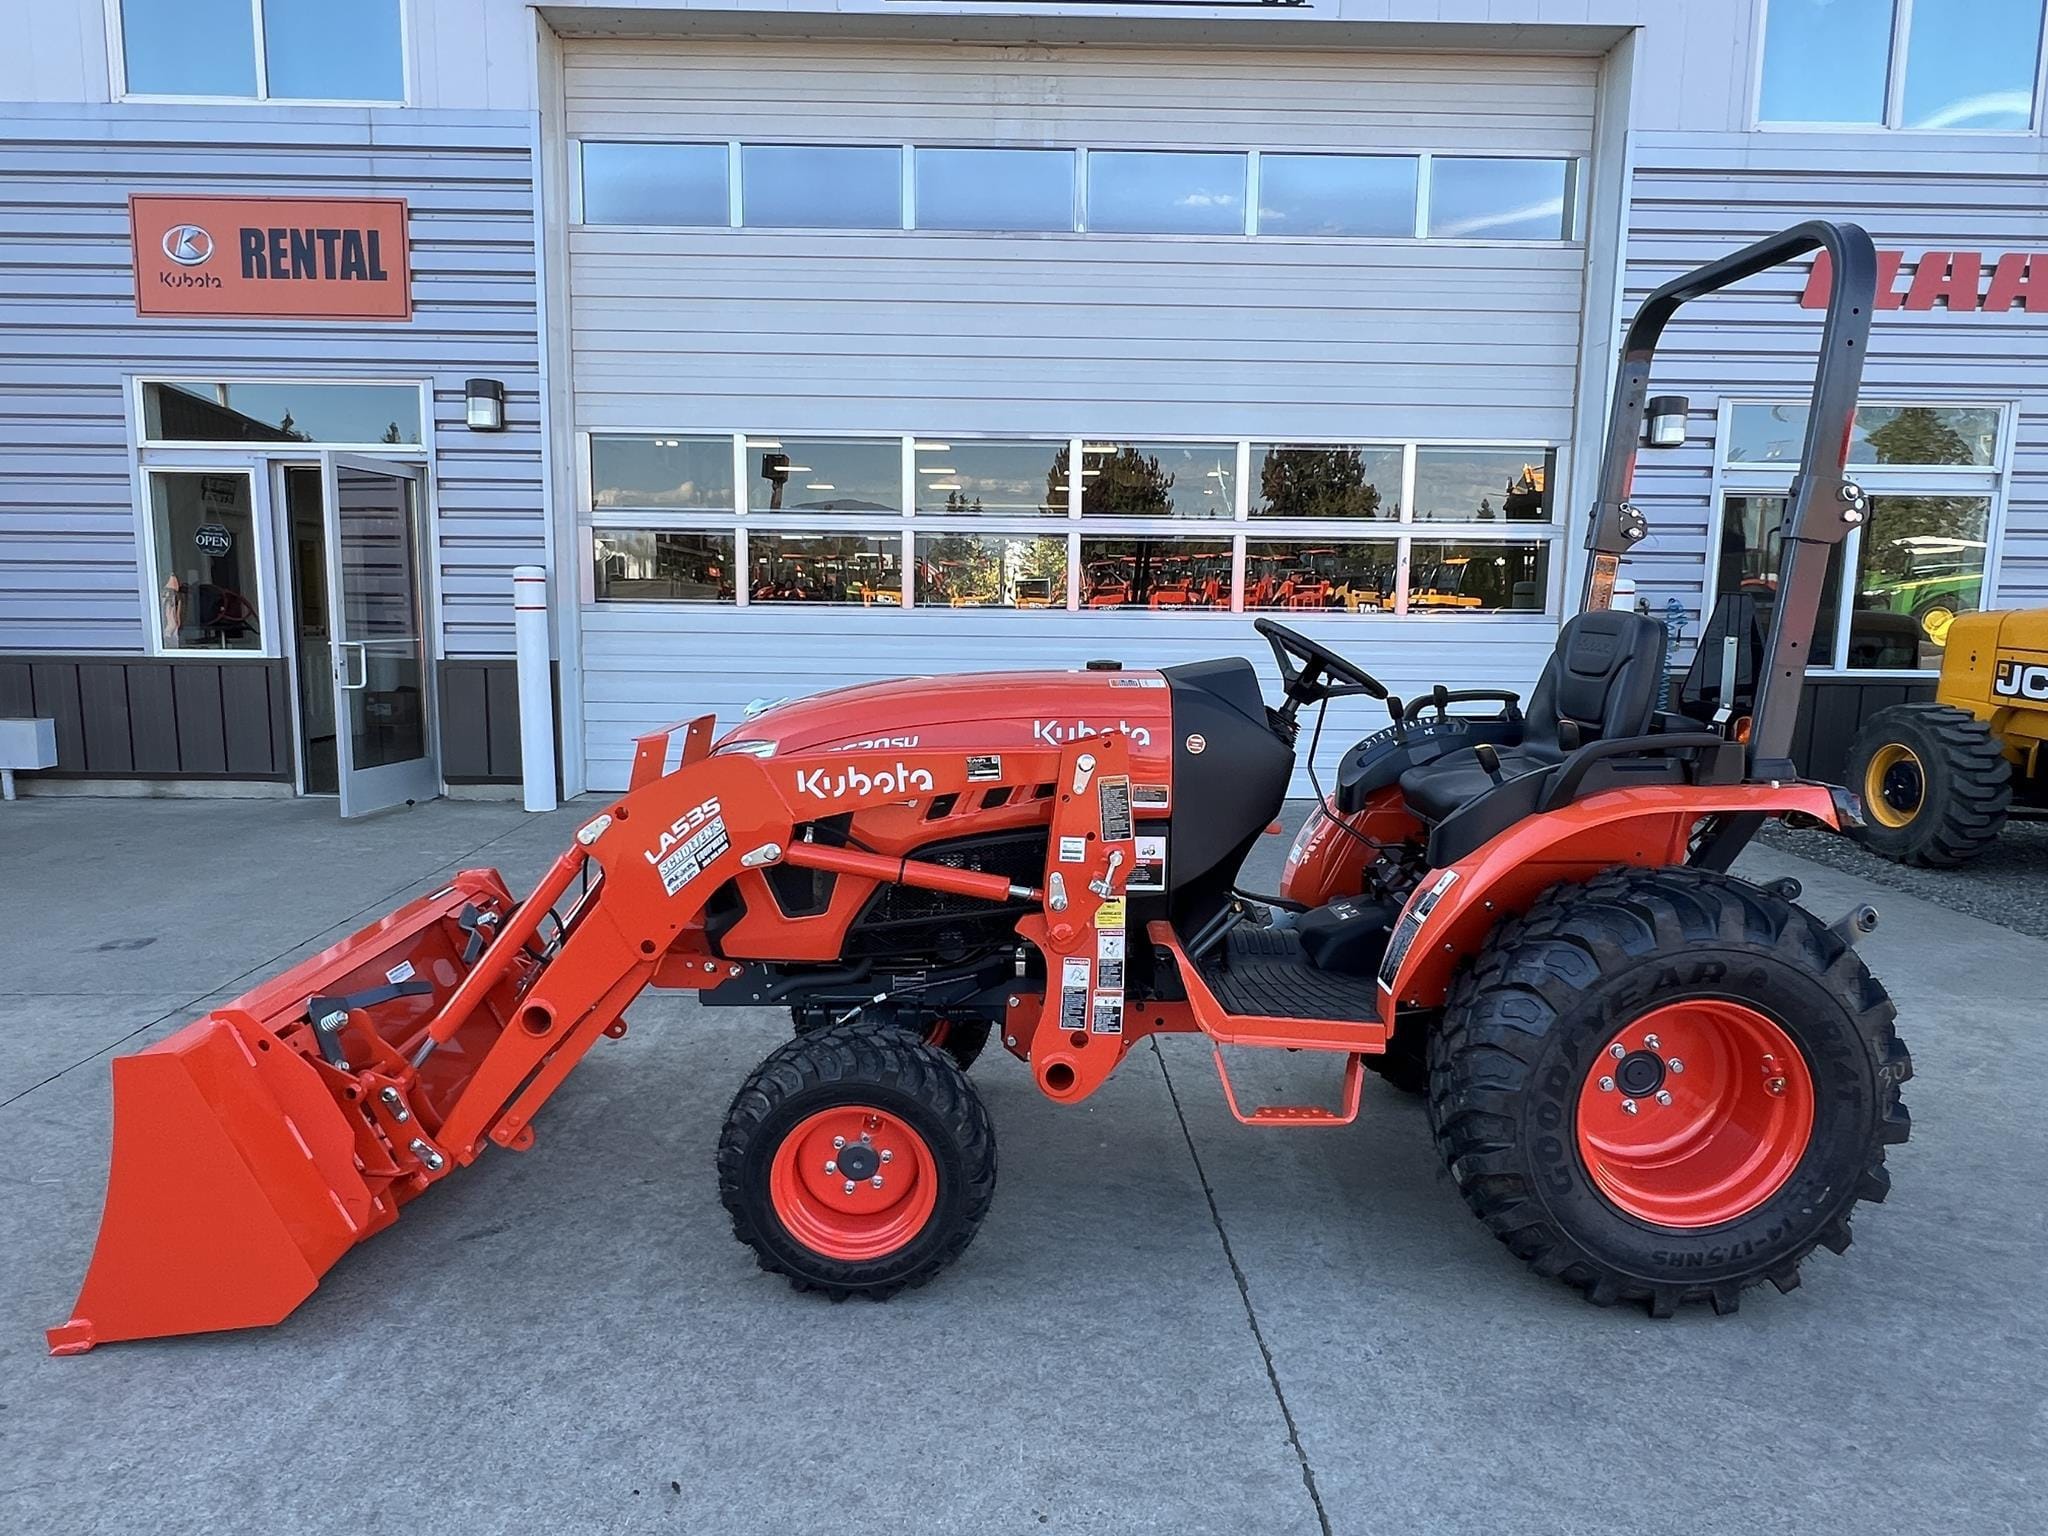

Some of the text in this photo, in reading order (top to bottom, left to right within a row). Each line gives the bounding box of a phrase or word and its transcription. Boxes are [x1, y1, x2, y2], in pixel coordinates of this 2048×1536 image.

[240, 228, 387, 280] RENTAL
[159, 271, 222, 288] Kubota
[195, 534, 229, 547] OPEN
[796, 762, 934, 799] Kubota
[643, 796, 721, 865] LA535
[1534, 961, 1728, 1196] GOODYEAR
